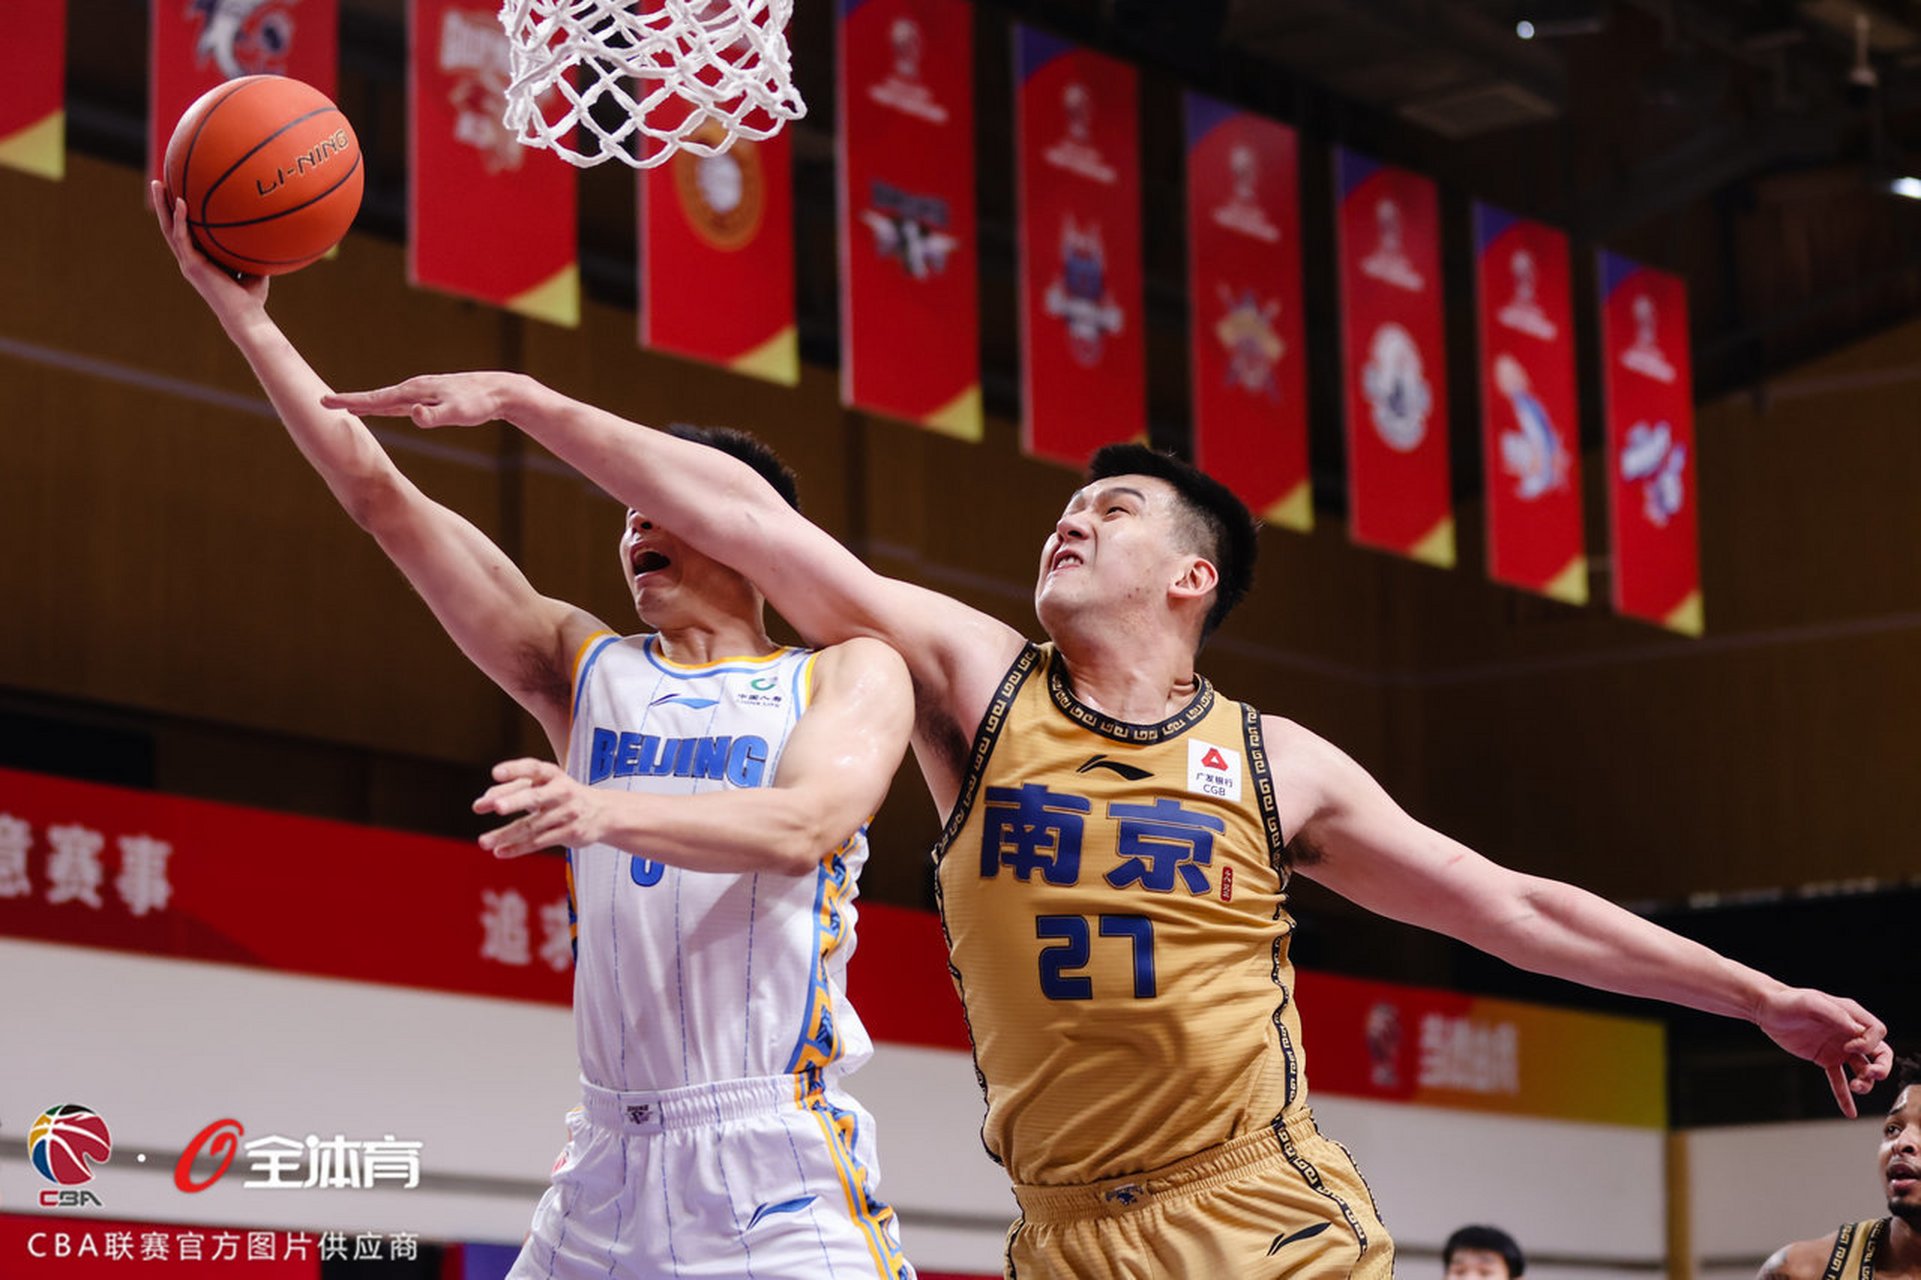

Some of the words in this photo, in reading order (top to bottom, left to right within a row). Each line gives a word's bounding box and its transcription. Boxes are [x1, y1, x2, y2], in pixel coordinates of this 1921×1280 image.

[256, 129, 349, 197] LI-NING
[589, 727, 770, 788] BEIJING
[1203, 783, 1226, 797] CGB
[980, 783, 1227, 895] 南京
[1035, 914, 1157, 1000] 27
